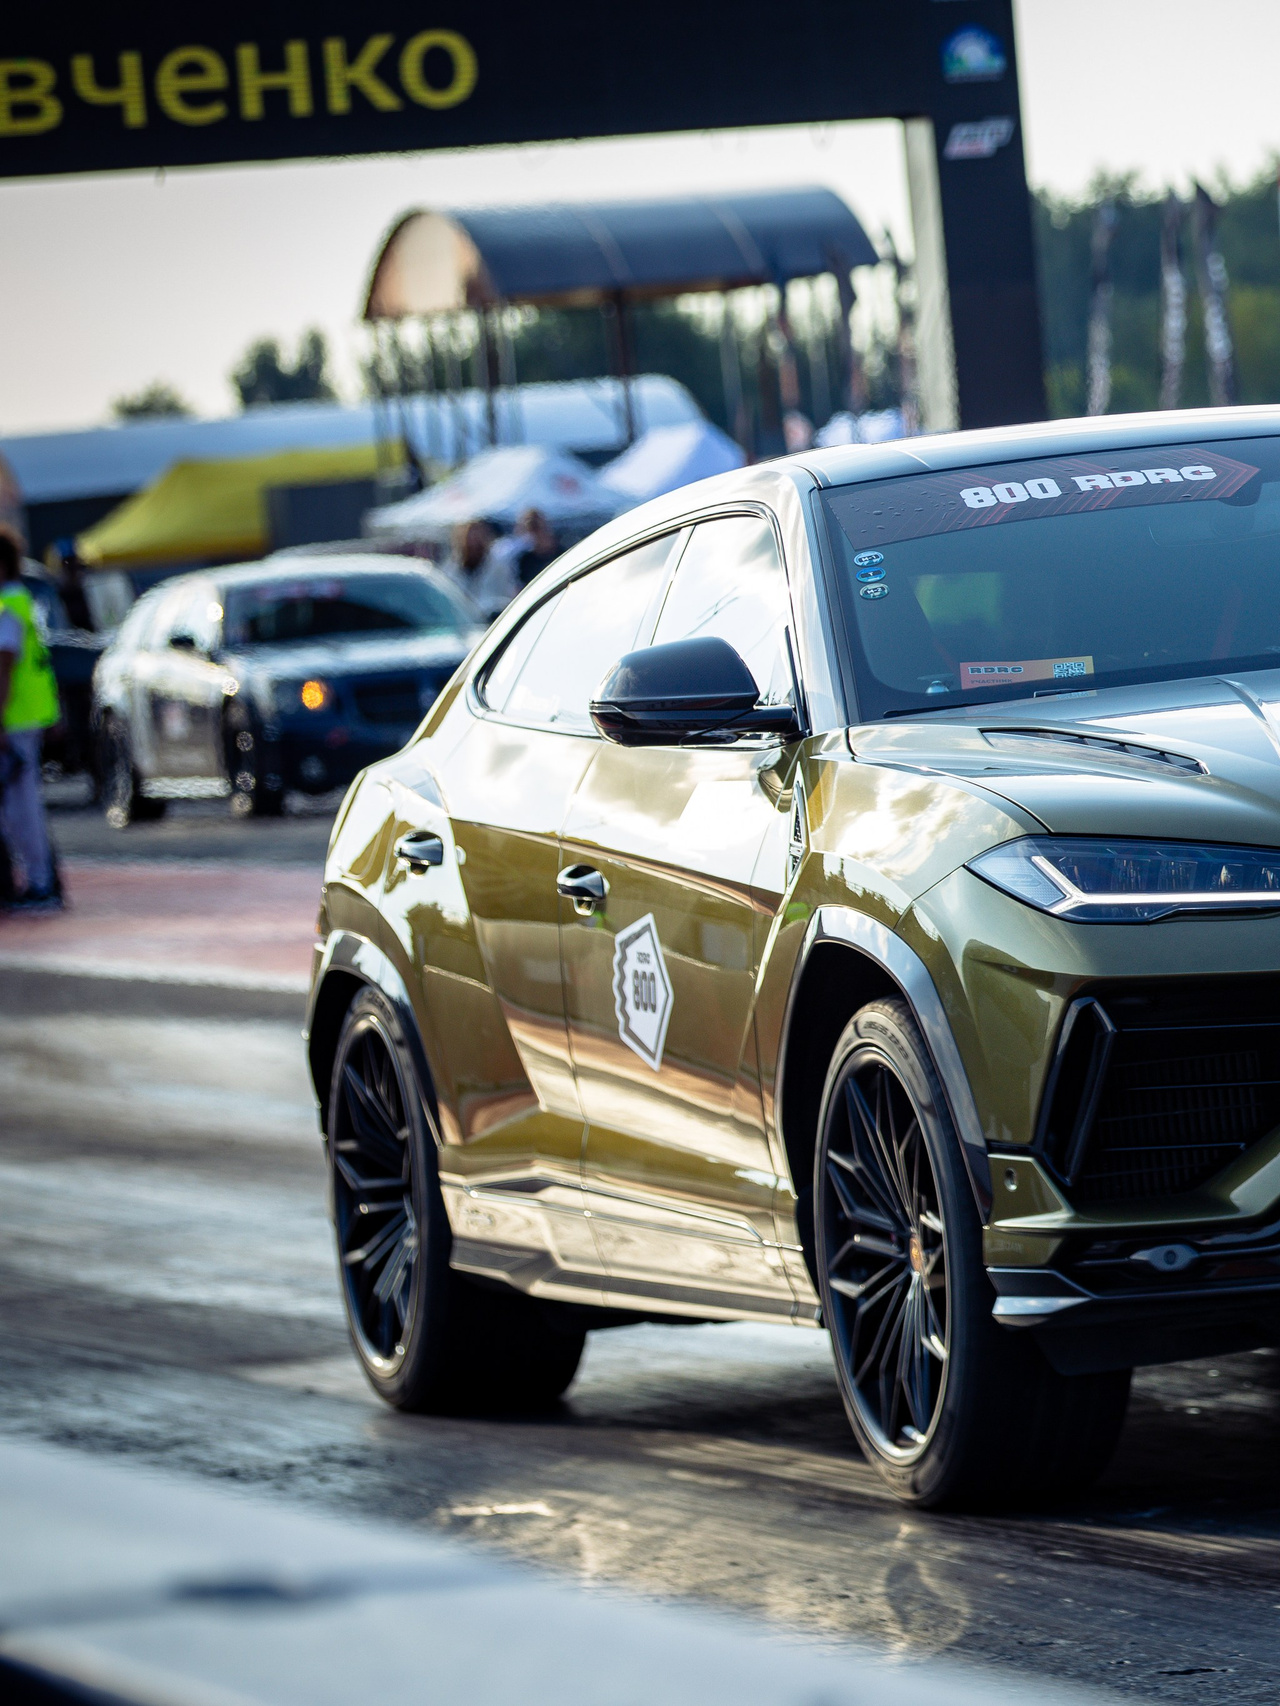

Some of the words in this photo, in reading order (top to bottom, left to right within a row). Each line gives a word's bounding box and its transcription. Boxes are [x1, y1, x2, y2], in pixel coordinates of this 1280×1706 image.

[0, 28, 478, 137] вченко
[959, 478, 1062, 509] 800
[1070, 465, 1217, 492] RDRC
[968, 665, 1024, 675] RDRC
[633, 969, 657, 1014] 800
